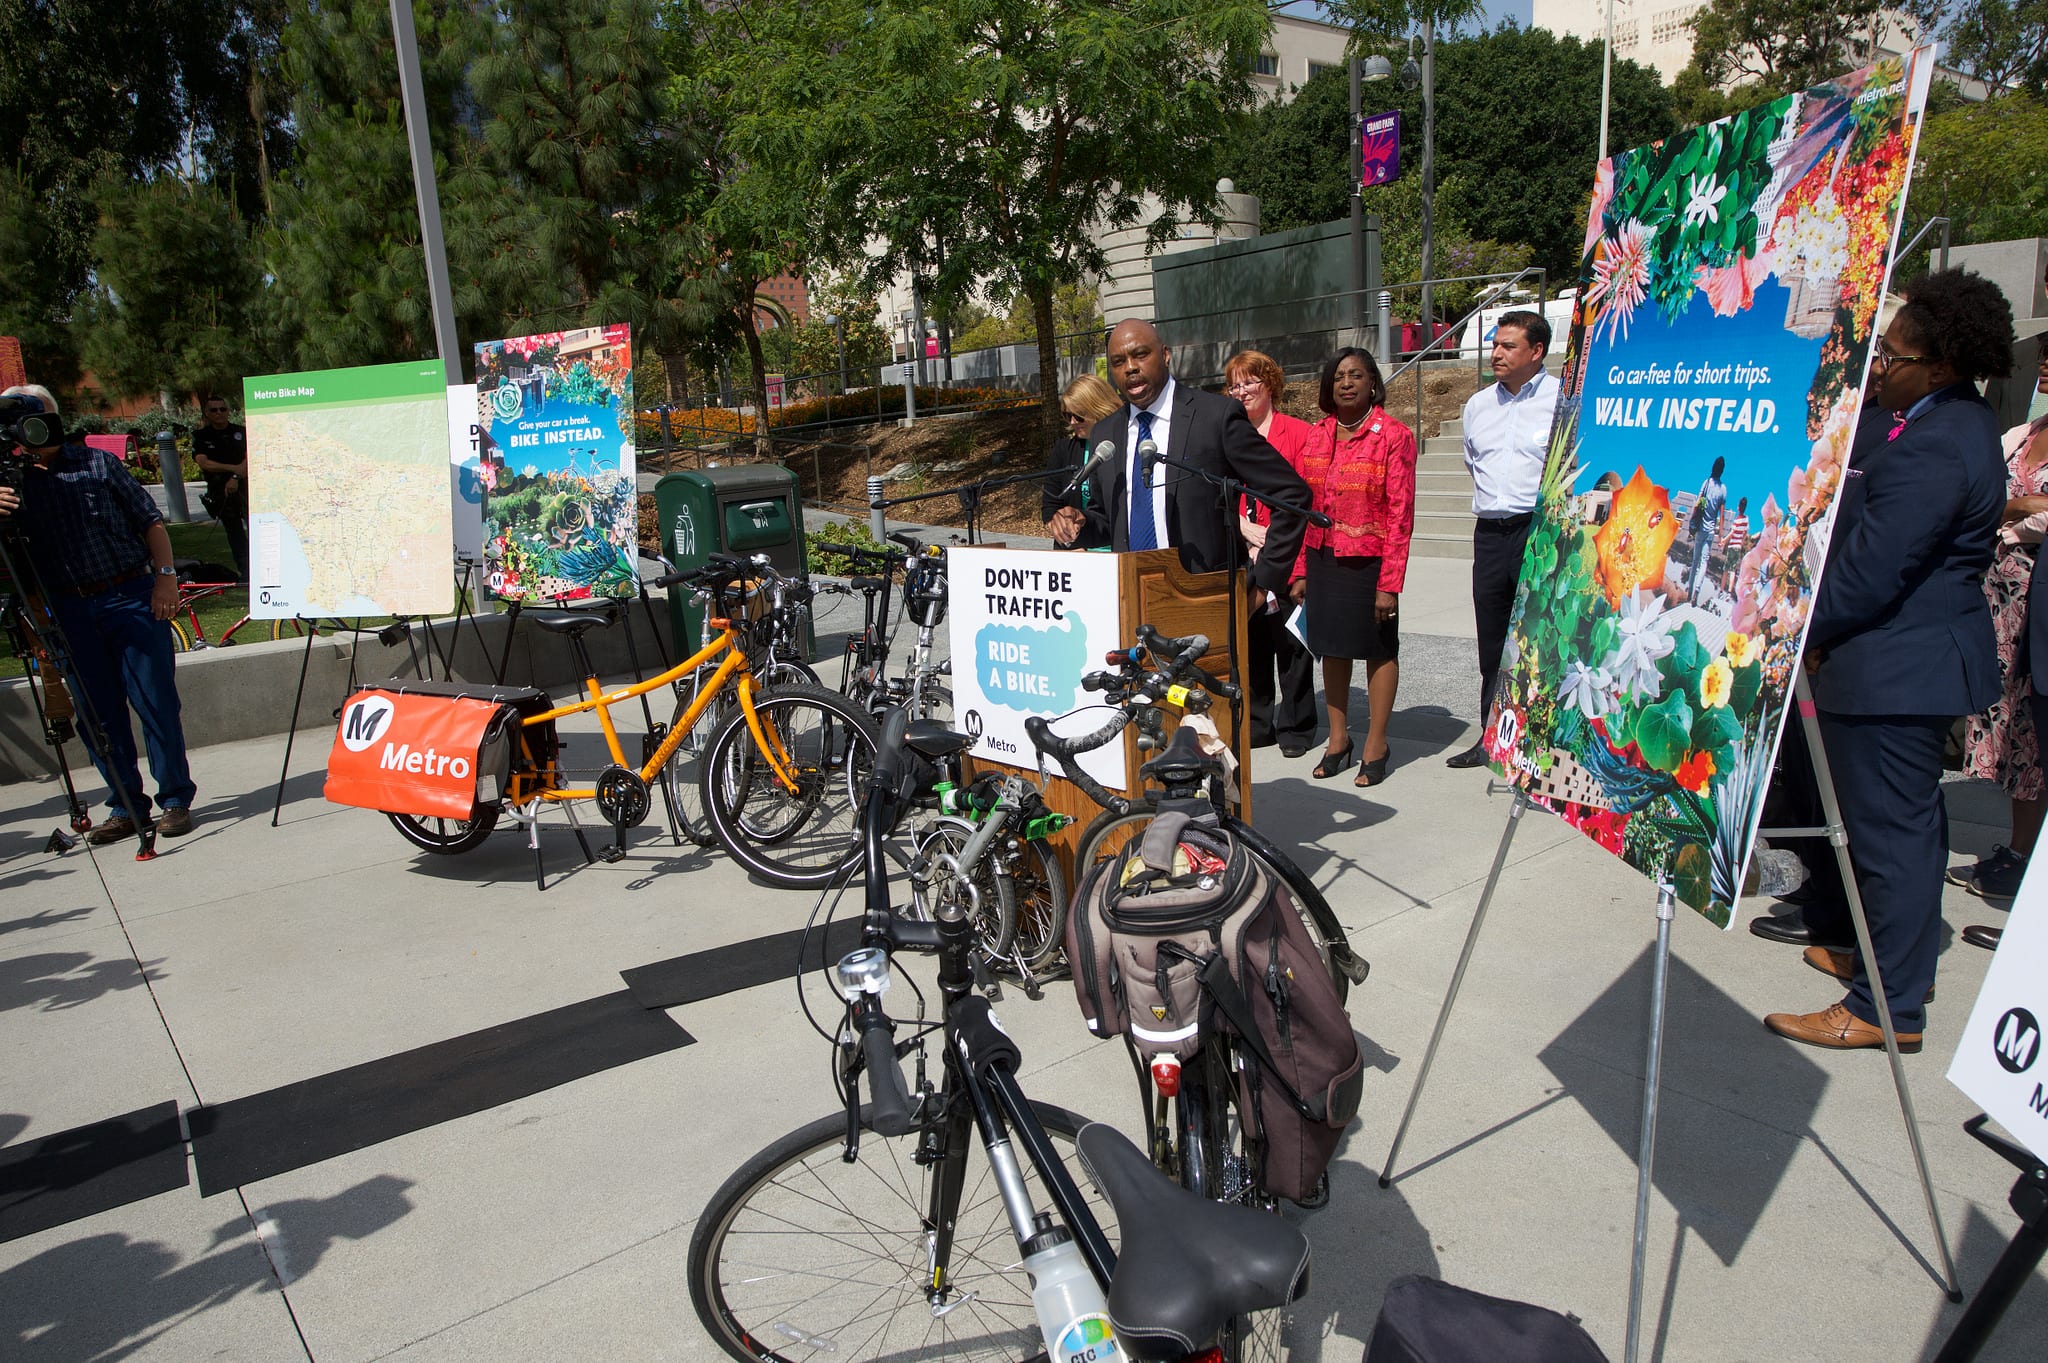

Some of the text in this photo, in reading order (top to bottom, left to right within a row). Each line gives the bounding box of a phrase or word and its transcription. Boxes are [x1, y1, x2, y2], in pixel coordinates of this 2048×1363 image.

[1856, 78, 1908, 105] metro.net
[1366, 120, 1382, 133] GRAND
[1382, 117, 1395, 128] PARK
[1608, 360, 1772, 391] Go car-free for short trips.
[254, 386, 315, 400] Metro Bike Map
[518, 420, 535, 430] Give
[535, 419, 551, 431] your
[552, 419, 563, 428] car
[569, 414, 591, 425] break.
[1595, 396, 1780, 434] WALK INSTEAD.
[510, 427, 605, 448] BIKE INSTEAD.
[985, 567, 1072, 593] DON'T BE
[985, 593, 1064, 620] TRAFFIC
[988, 640, 1031, 665] RIDE
[989, 668, 1057, 697] A BIKE.
[987, 735, 1017, 754] Metro
[380, 742, 470, 779] Metro
[1512, 747, 1541, 779] Metro
